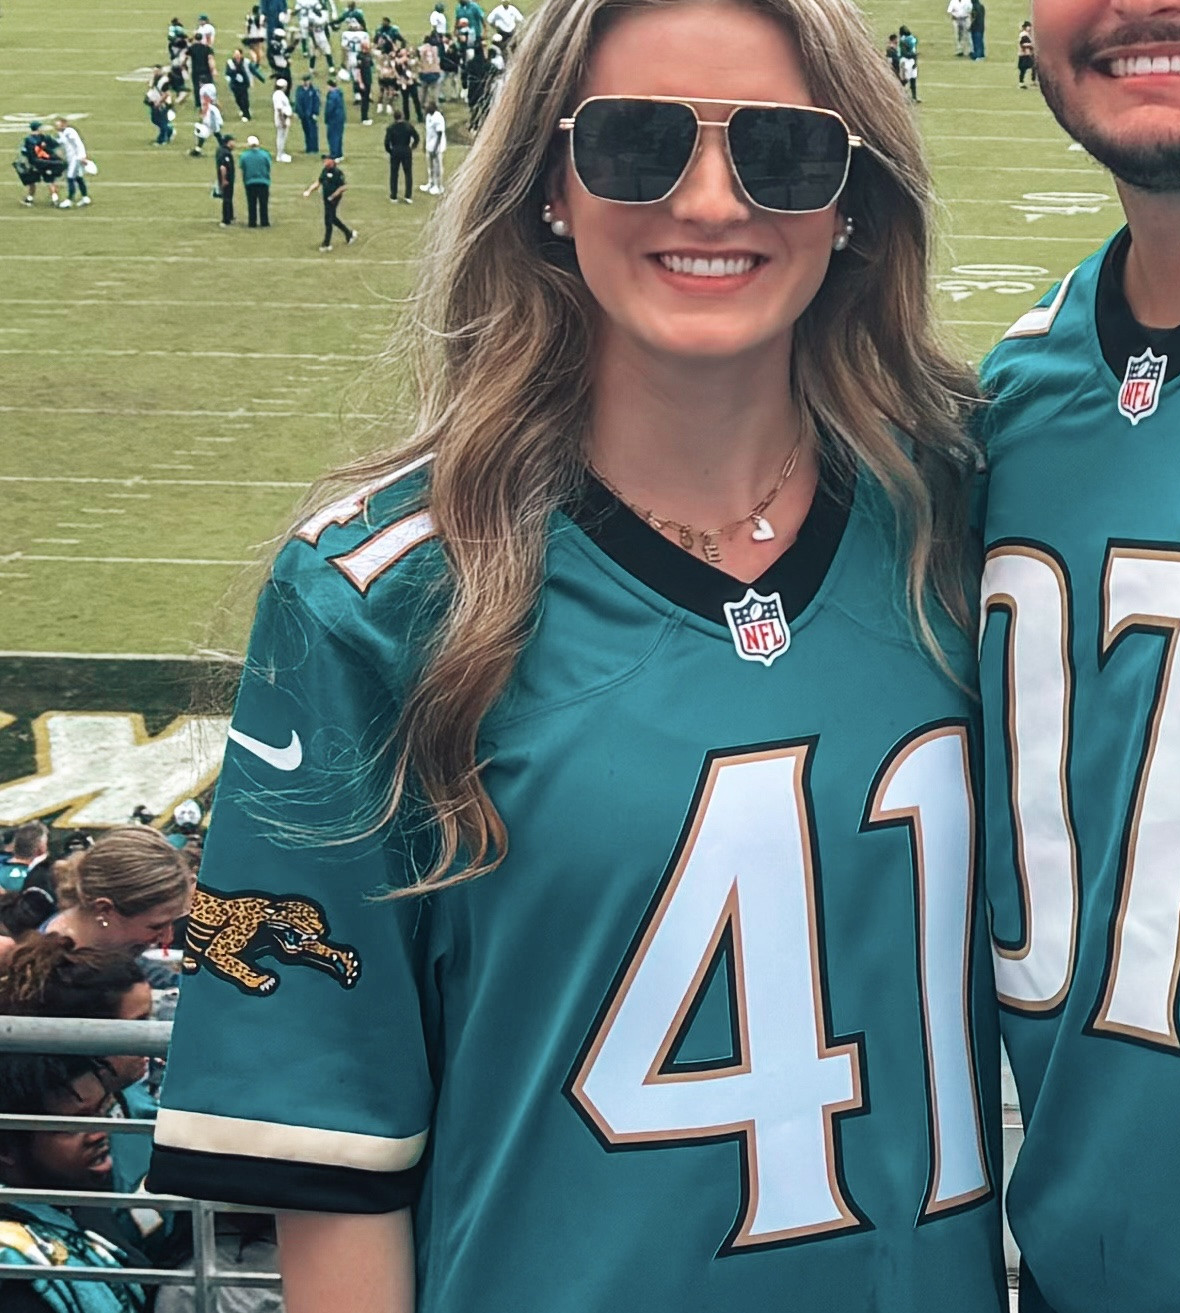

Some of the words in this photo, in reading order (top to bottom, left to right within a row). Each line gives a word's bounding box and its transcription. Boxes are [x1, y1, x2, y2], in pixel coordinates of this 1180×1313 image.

[1122, 380, 1150, 410] NFL
[742, 621, 782, 651] NFL
[570, 717, 996, 1259] 41
